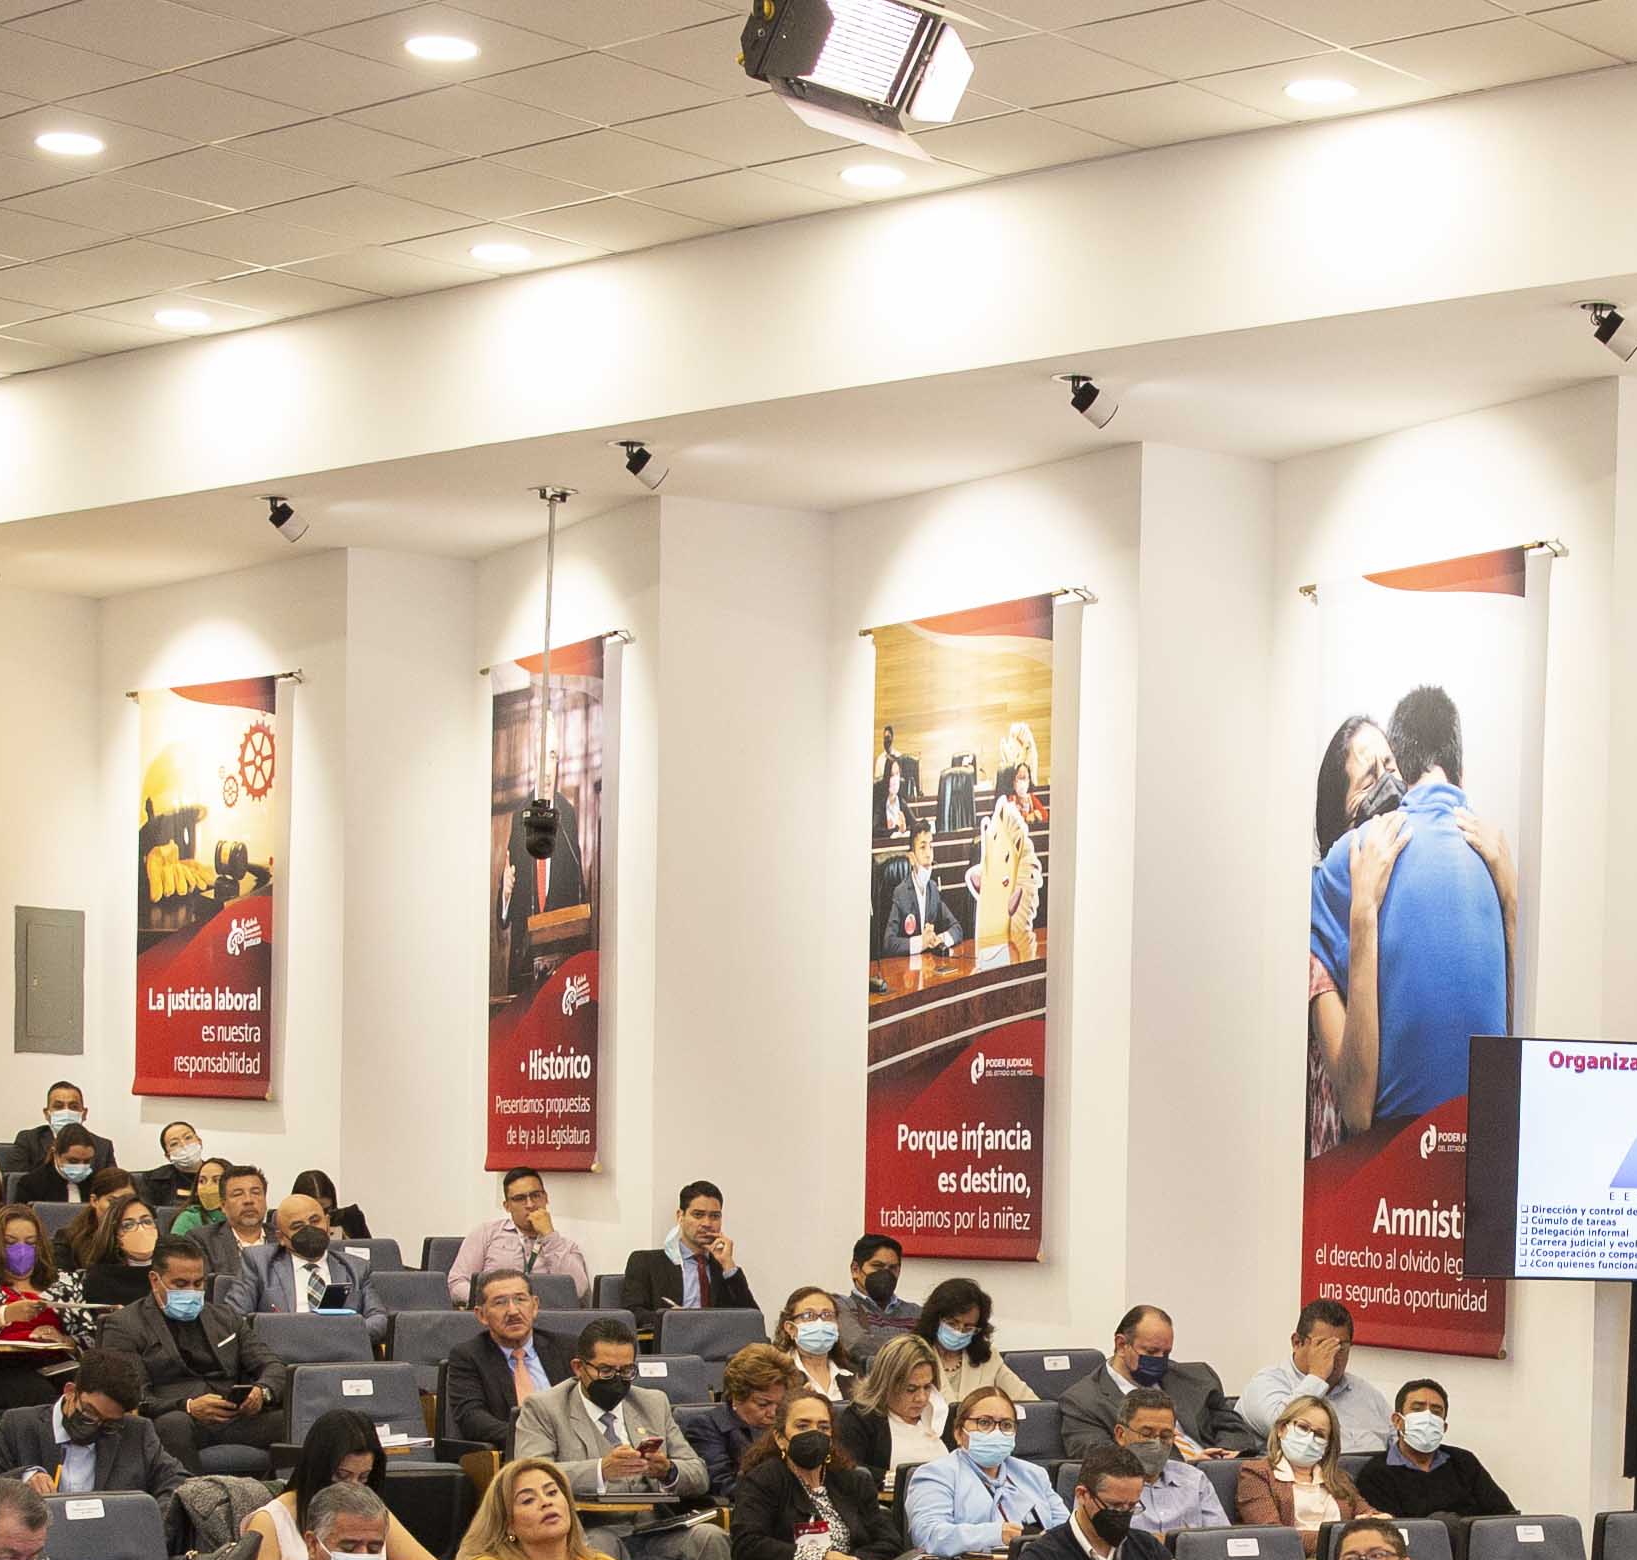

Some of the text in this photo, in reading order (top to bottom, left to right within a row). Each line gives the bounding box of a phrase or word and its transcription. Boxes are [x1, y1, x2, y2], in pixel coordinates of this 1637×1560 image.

[148, 986, 261, 1018] La justicia laboral
[201, 1023, 261, 1042] es nuestra
[174, 1051, 261, 1078] responsabilidad
[529, 1044, 591, 1081] Histórico
[495, 1095, 591, 1119] Presentamos propuestas
[506, 1124, 591, 1150] de ley a la Legislatura
[897, 1122, 1032, 1159] Porque infancia
[1438, 1132, 1461, 1142] PODER
[938, 1164, 1031, 1199] es destino,
[880, 1205, 1030, 1235] trabajamos por la niñez
[1531, 1216, 1617, 1226] Cúmulo de tareas
[1532, 1205, 1578, 1214] Dirección
[1581, 1208, 1586, 1216] y
[1589, 1207, 1624, 1216] control
[1530, 1238, 1567, 1247] Carrera
[1570, 1239, 1606, 1248] judicial
[1609, 1241, 1614, 1249] y
[1531, 1227, 1629, 1238] Delegación informal
[1316, 1243, 1464, 1281] el derecho al olvido leg
[1530, 1249, 1596, 1259] ¿Cooperación
[1530, 1259, 1554, 1268] ¿Con
[1557, 1260, 1595, 1270] quienes
[1319, 1281, 1487, 1313] una segunda oportunidad
